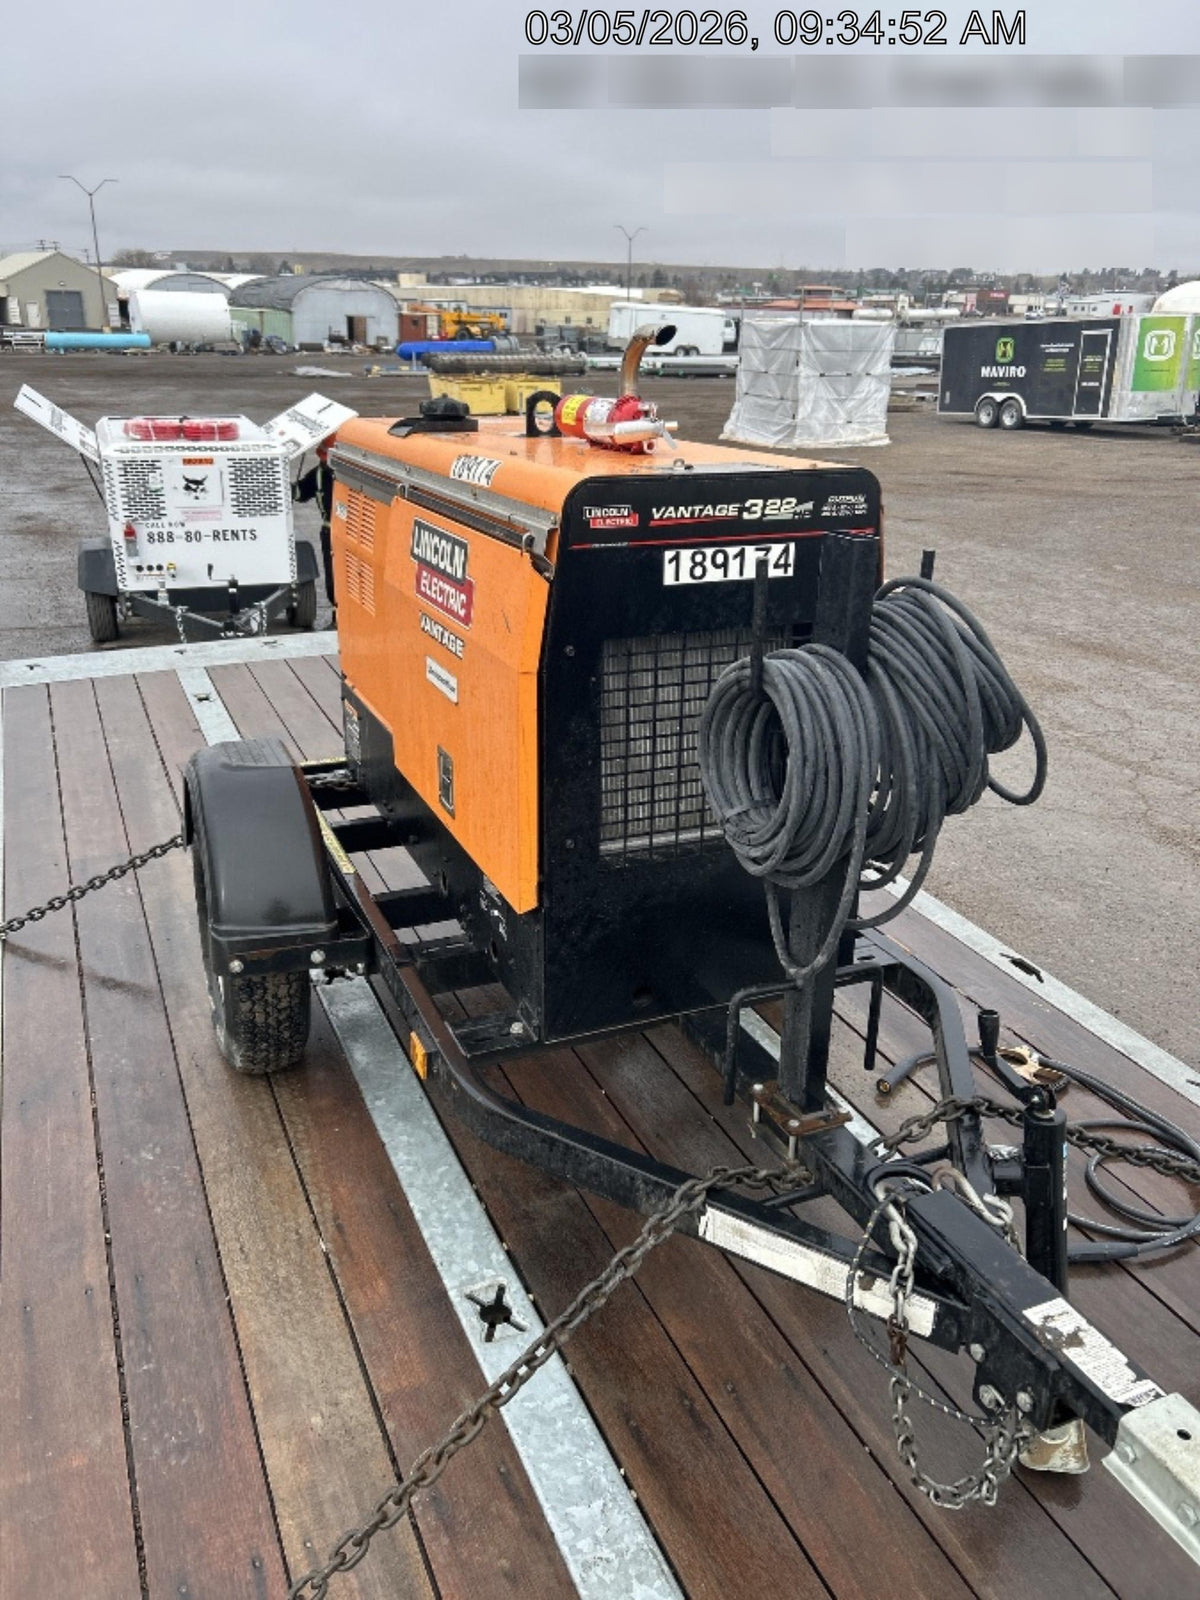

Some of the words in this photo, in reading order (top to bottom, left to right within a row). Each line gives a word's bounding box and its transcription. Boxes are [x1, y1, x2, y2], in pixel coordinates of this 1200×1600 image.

[981, 365, 1027, 379] MAVIRO
[585, 507, 628, 518] LINCOLN
[651, 504, 740, 519] VANTAGE
[742, 497, 798, 519] 322
[146, 529, 257, 544] 888-80-RENTS
[413, 525, 465, 579] LINCOLN
[420, 570, 467, 617] ELECTRIC
[420, 613, 465, 659] VANTAGE
